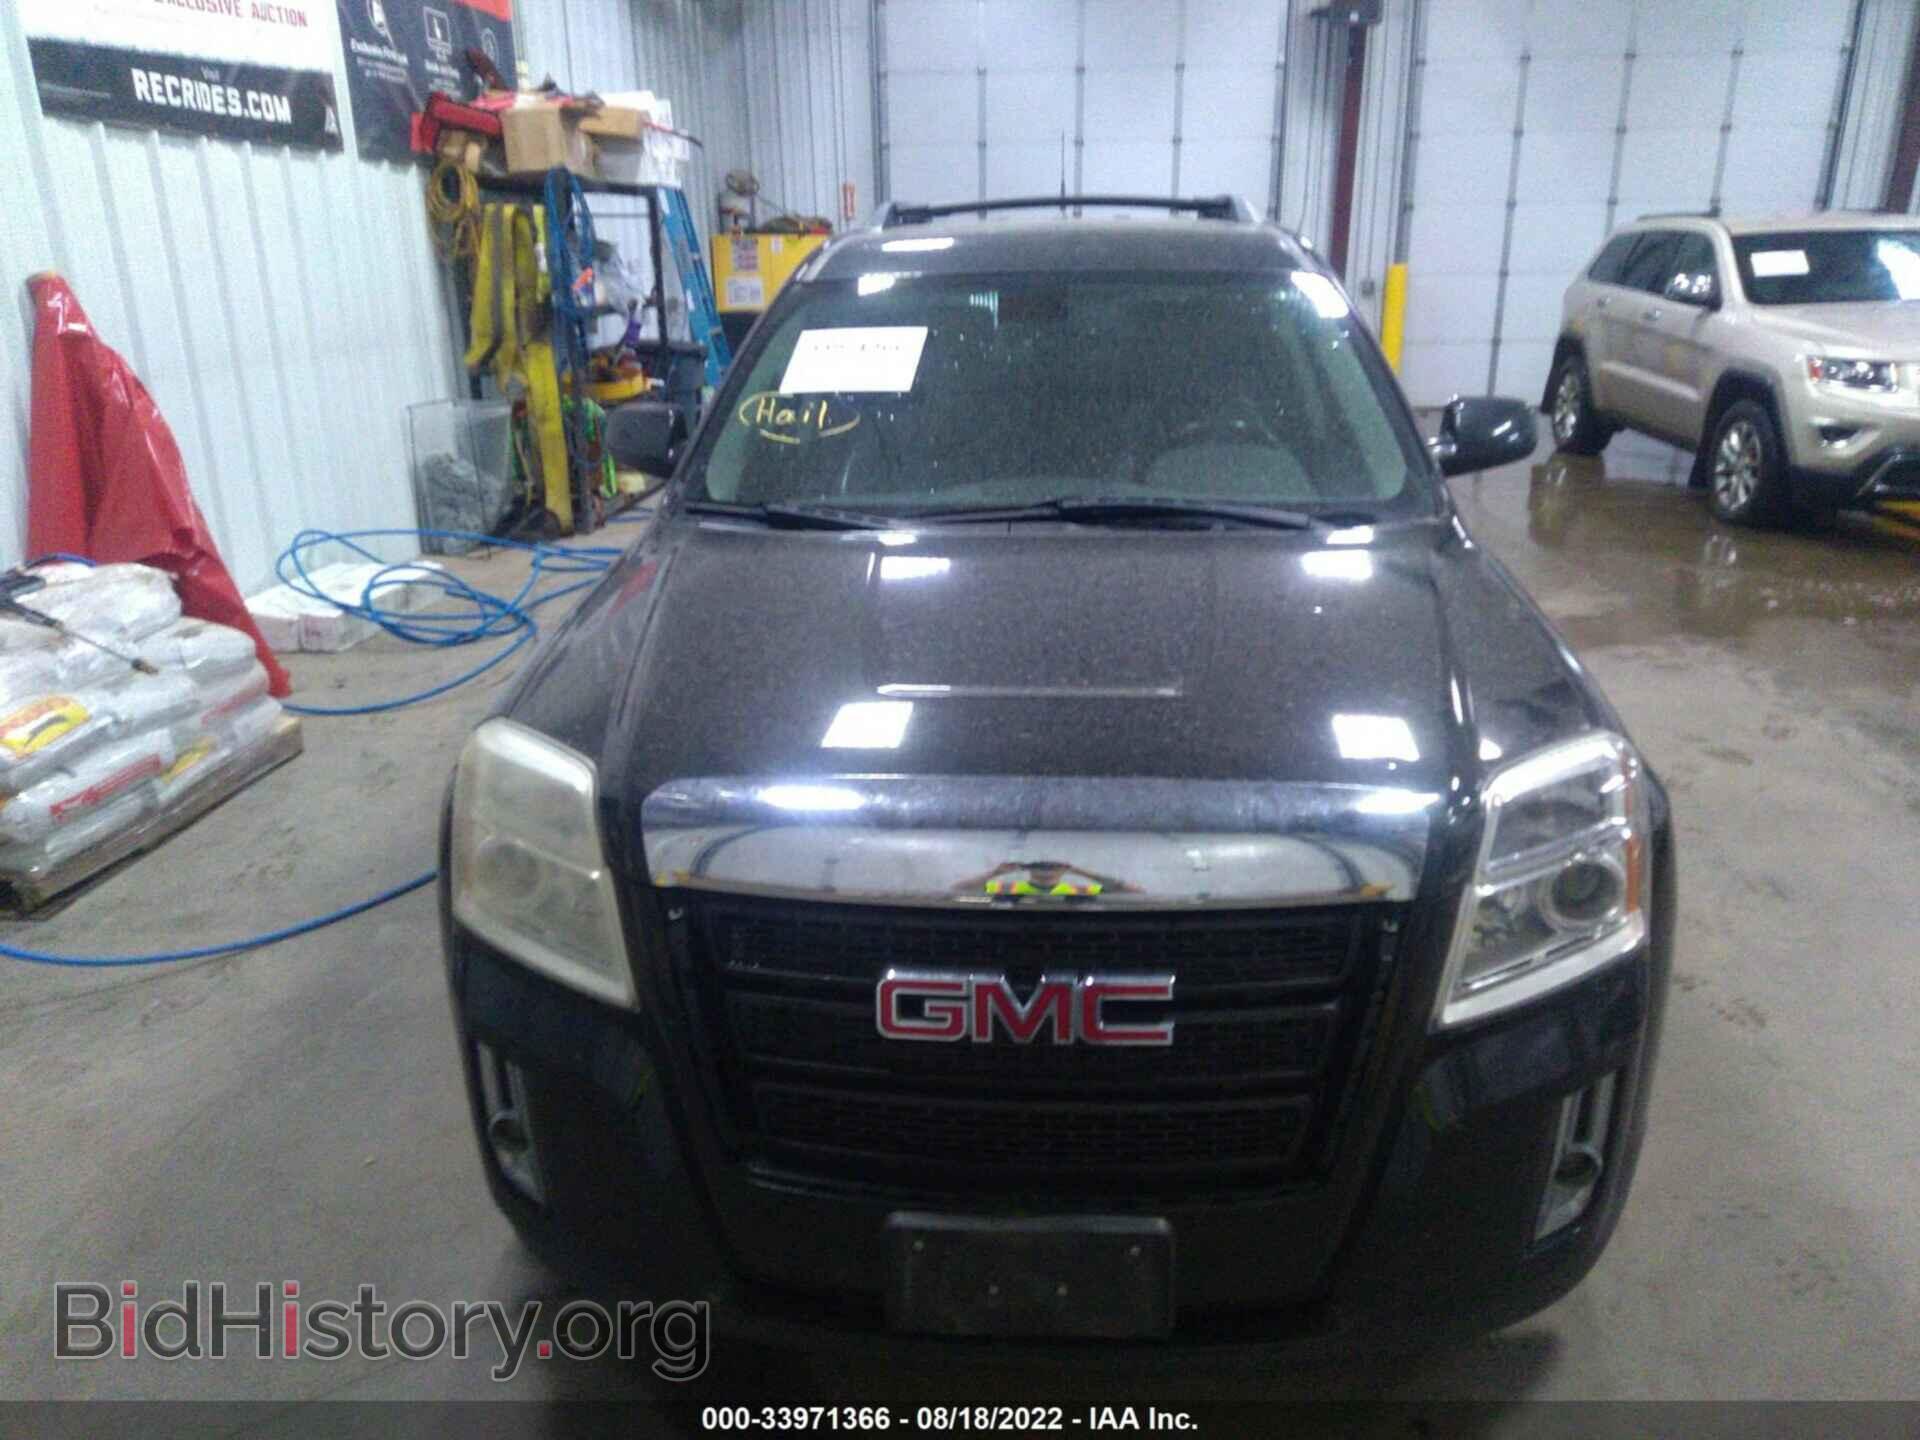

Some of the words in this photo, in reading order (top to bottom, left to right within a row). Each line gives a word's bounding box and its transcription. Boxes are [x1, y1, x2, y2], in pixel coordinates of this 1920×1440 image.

[154, 0, 242, 17] LUSIVE
[251, 3, 308, 27] AUCTION
[131, 67, 292, 124] RECRIDES.COM
[756, 397, 828, 429] Hail
[876, 968, 1175, 1046] GMC
